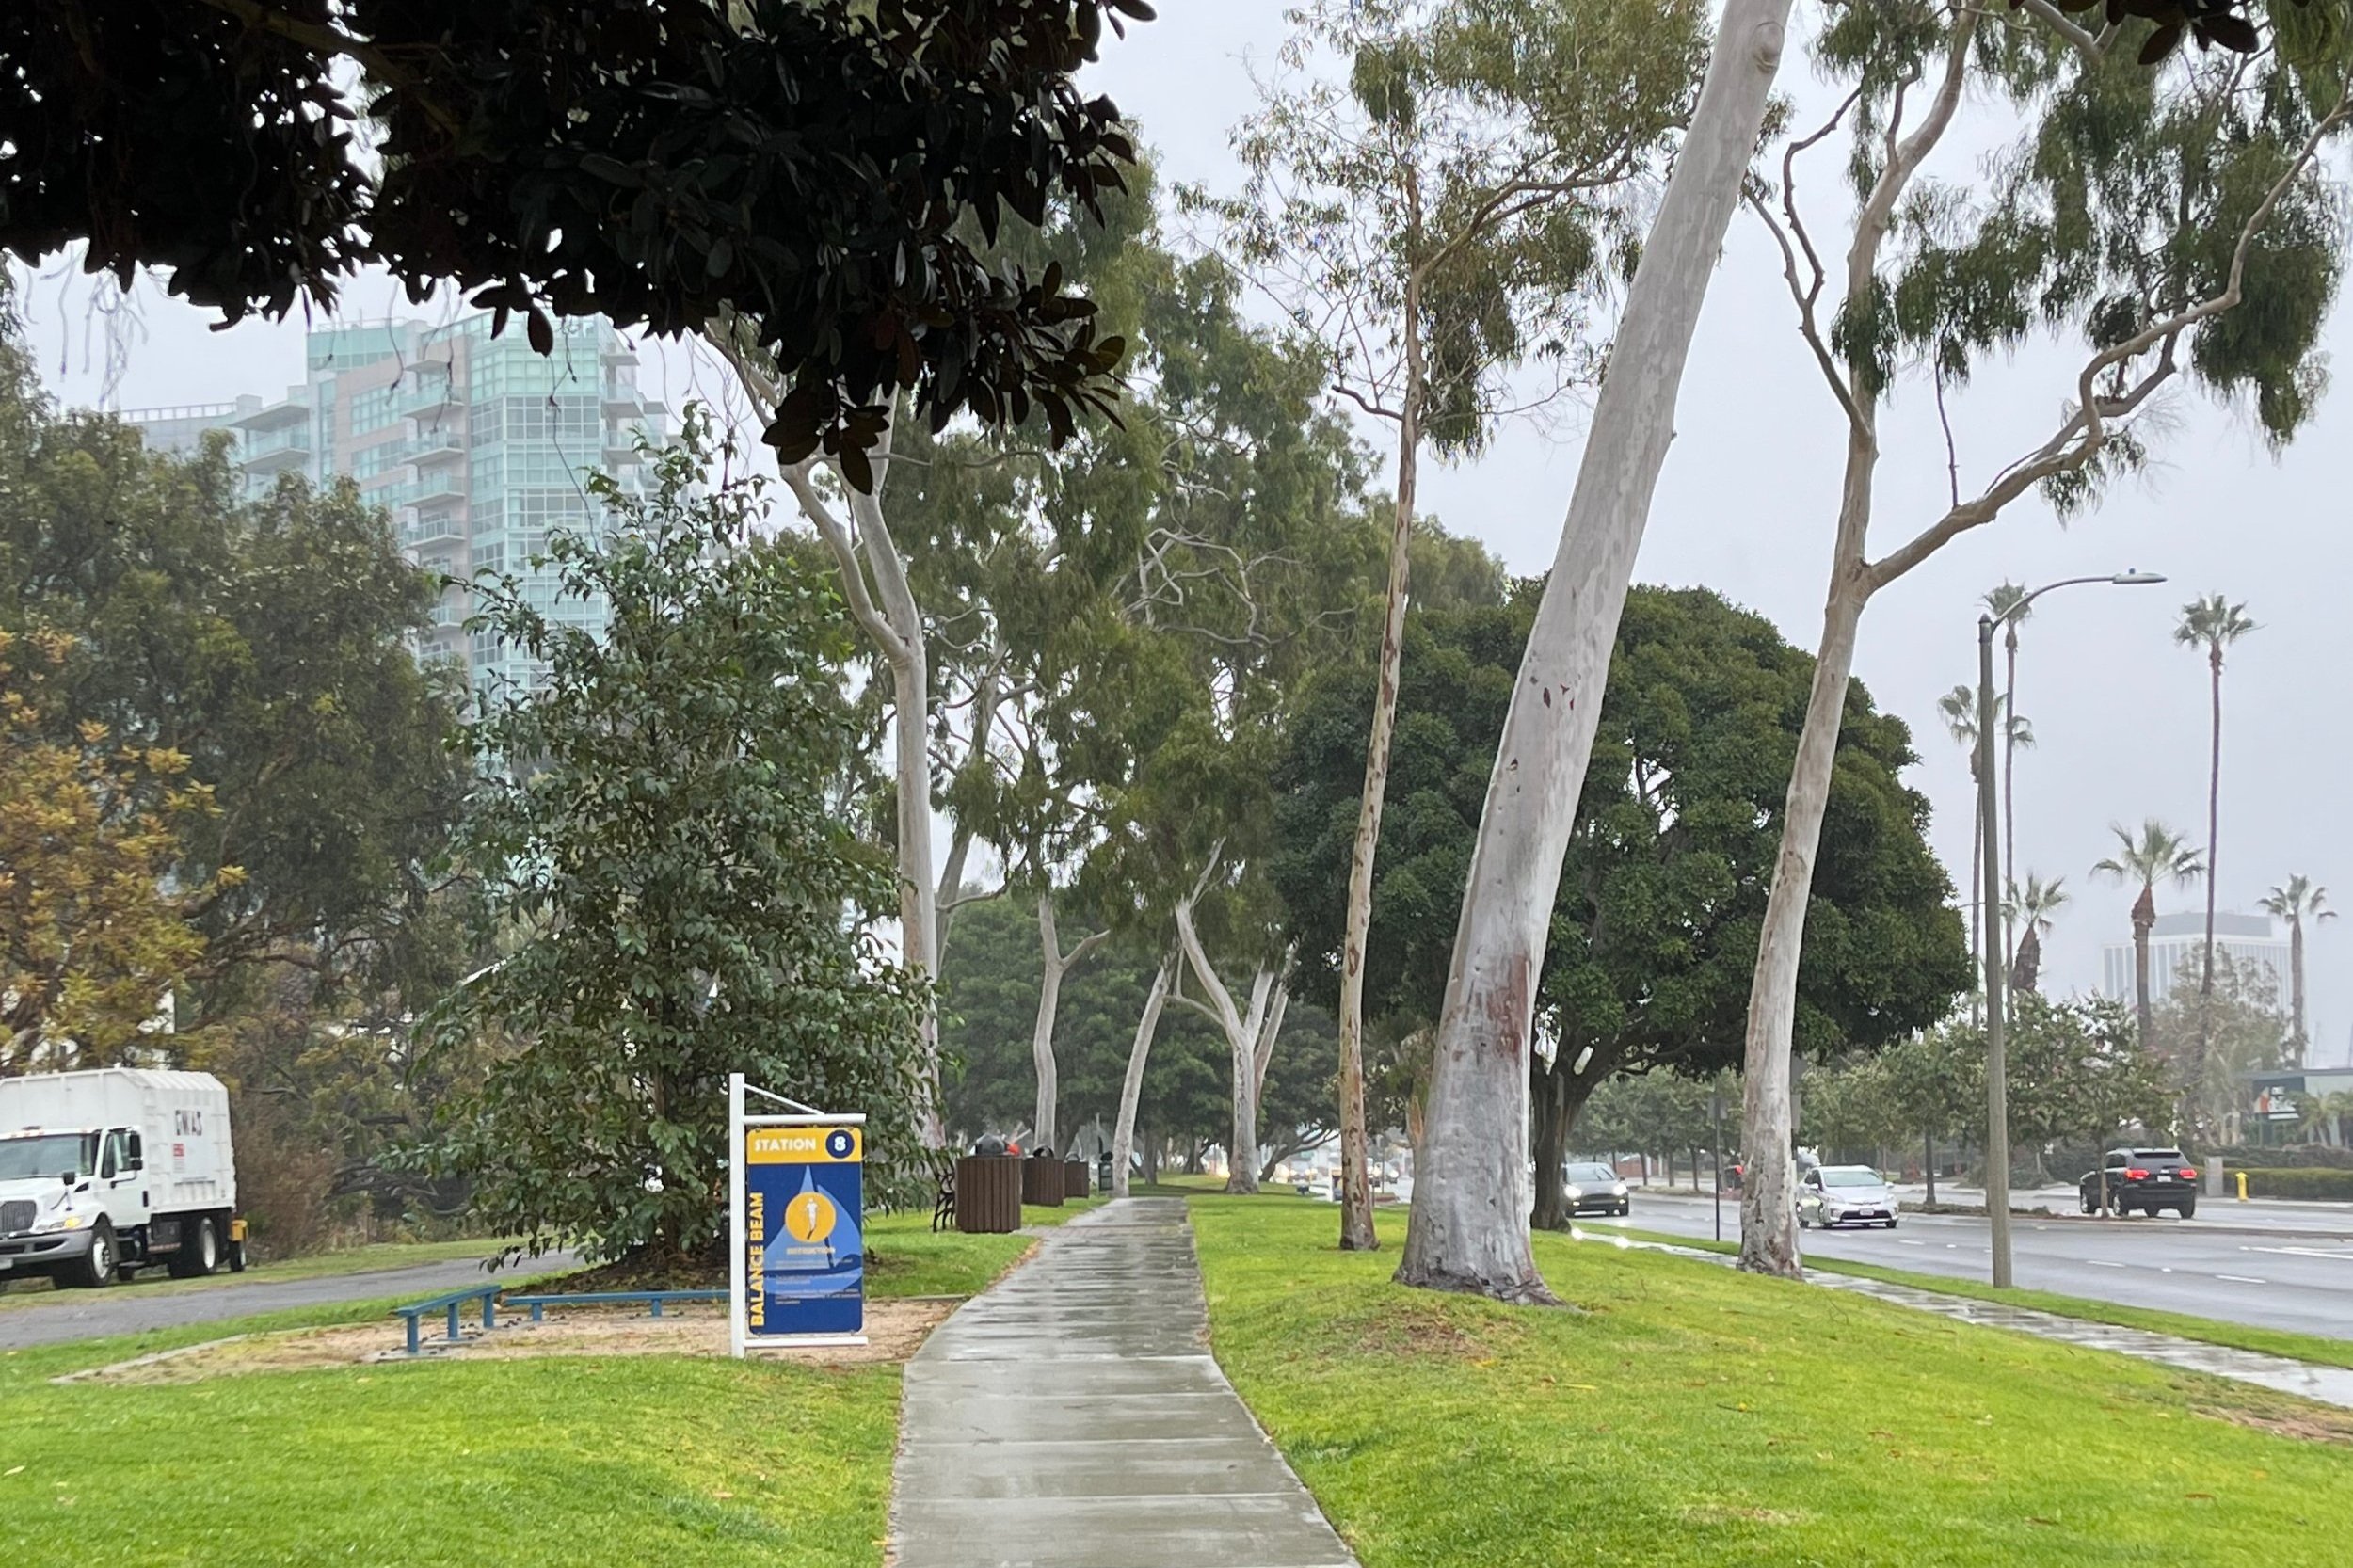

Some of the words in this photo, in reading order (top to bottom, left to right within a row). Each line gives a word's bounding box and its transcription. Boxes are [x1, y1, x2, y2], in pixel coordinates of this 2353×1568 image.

[755, 1138, 817, 1152] STATION
[834, 1135, 847, 1152] 8
[749, 1192, 764, 1241] BEAM
[749, 1245, 765, 1327] BALANCE
